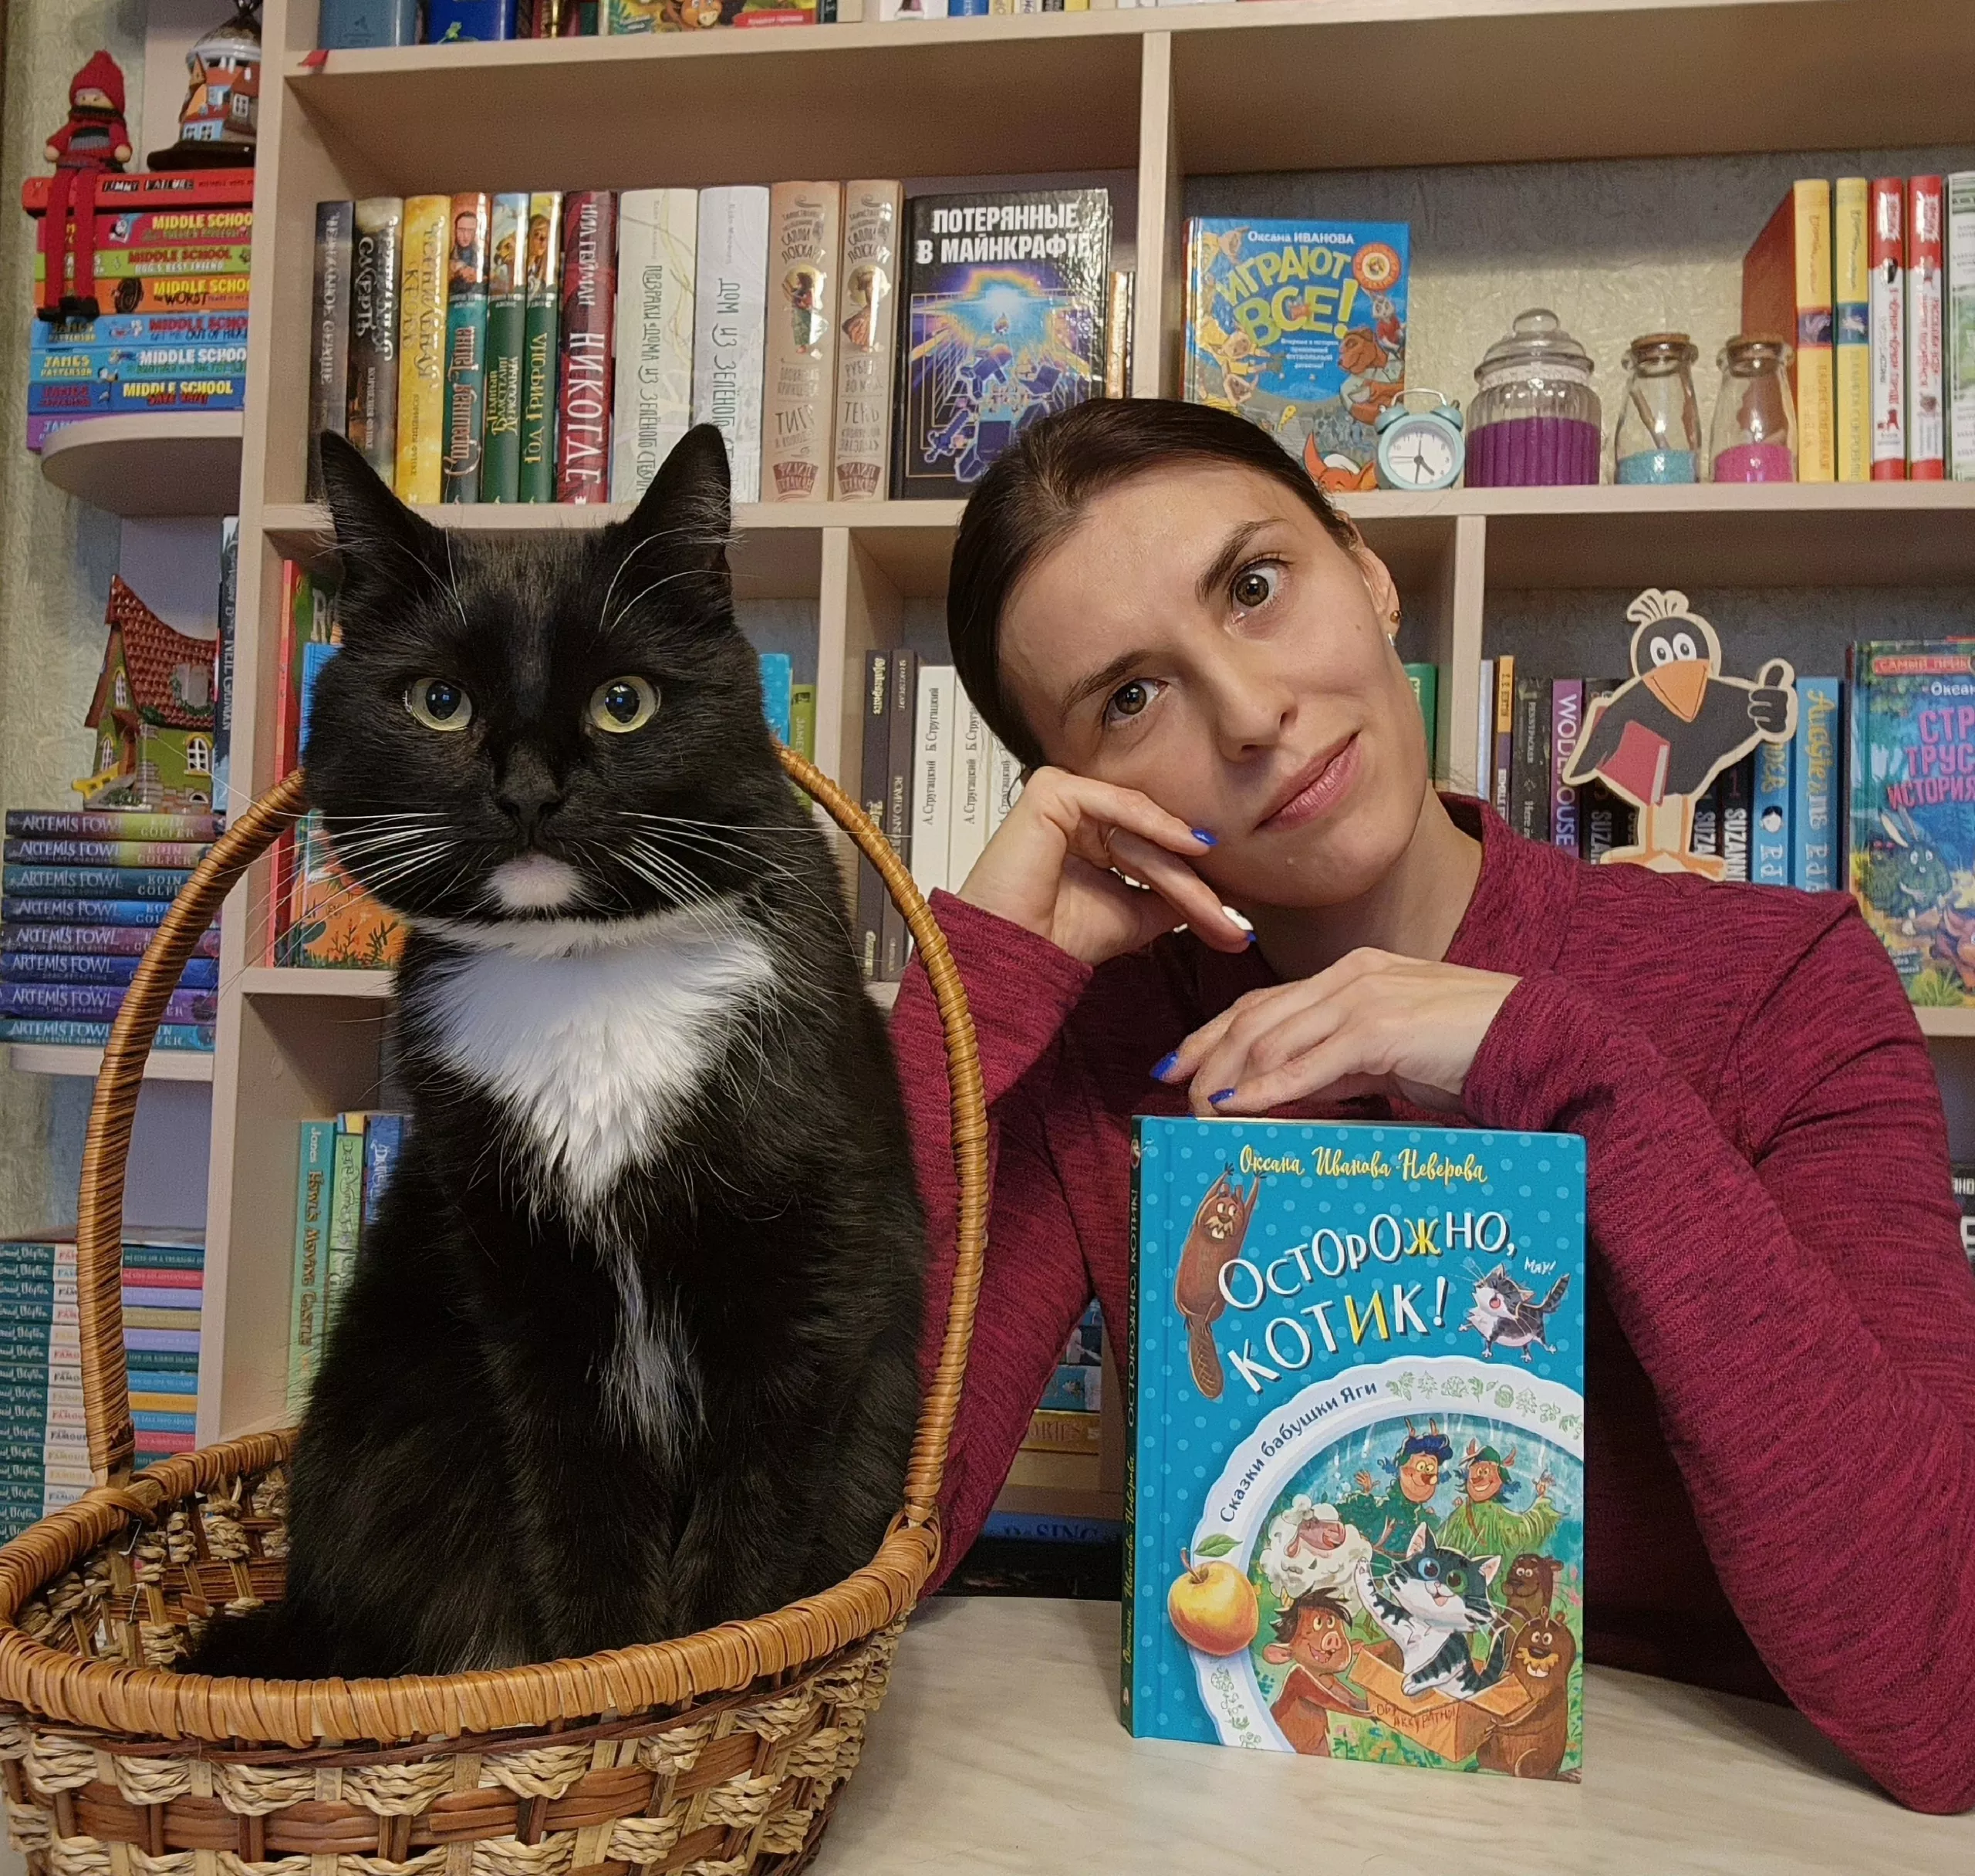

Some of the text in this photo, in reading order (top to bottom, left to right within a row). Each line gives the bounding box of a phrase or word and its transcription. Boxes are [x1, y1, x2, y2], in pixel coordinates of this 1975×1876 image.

[152, 212, 252, 230] MIDDLE SCHOO
[931, 203, 1080, 233] ПОТЕРЯННЫЕ
[916, 231, 1092, 264] В МАЙНКРАФТЕ
[1248, 231, 1354, 245] Оксана ИВАНОВА
[129, 250, 232, 264] MIDDLE SCHOOL
[577, 204, 598, 306] НИЛ ГЕЙМАН
[154, 278, 250, 294] MIDDLE SCHO
[355, 236, 377, 339] СМЕРТЬ
[1214, 245, 1352, 307] ИГРАЮТ
[165, 292, 209, 306] WORST
[642, 265, 663, 320] ПРИЗРАКИ
[717, 278, 741, 315] ДОМ
[149, 317, 249, 332] MIDDLE SCHO
[1234, 278, 1359, 347] ВСЕ!
[711, 324, 737, 348] ИЗ
[44, 355, 90, 368] JAMES
[140, 348, 247, 365] MIDDLE SCHOO
[41, 368, 93, 377] PATTERSON
[637, 365, 658, 385] ИЗ
[123, 381, 233, 397] MIDDLE SCHOOL
[565, 332, 606, 484] НИКОГДЕ
[1879, 658, 1927, 671] САМЫЙ
[926, 687, 940, 741] Стругацкий
[1919, 705, 1975, 745] СТР
[1555, 694, 1577, 846] WODEOUSE
[1904, 743, 1975, 778] ТРУС
[892, 777, 903, 813] ROMEO
[923, 761, 937, 814] Стругацкий
[964, 759, 977, 814] Стругацкий
[22, 815, 77, 832] ARTEMIS
[141, 828, 194, 838] COLFER
[1693, 811, 1716, 855] SUZA
[1591, 811, 1612, 864] SUZA
[19, 842, 76, 858] ARTEMIS
[138, 855, 192, 865] COLFER
[20, 870, 124, 888] ARTEMIS FOWL
[137, 886, 181, 896] COLF
[148, 875, 182, 885] EOIN
[19, 900, 119, 916] ARTEMIS FOWL
[16, 928, 120, 945] ARTEMIS FOWL
[12, 955, 115, 973] ARTEMIS FOWL
[12, 989, 115, 1008] ARTEMIS FOWL
[11, 1021, 66, 1037] ARTEMIS
[309, 1127, 322, 1162] Jones
[1239, 1143, 1305, 1177] Оксана
[302, 1226, 319, 1286] MOVING
[1217, 1210, 1518, 1312] ОСТОРОЖНО,
[299, 1292, 317, 1346] CASTLE
[1127, 1188, 1139, 1428] ОСТОРОЖНО, КОТИК!
[1227, 1275, 1449, 1395] КОТИК!
[54, 1350, 79, 1358] FAMO
[54, 1372, 80, 1382] FAMO
[1220, 1381, 1379, 1524] Сказки бабушки Яги
